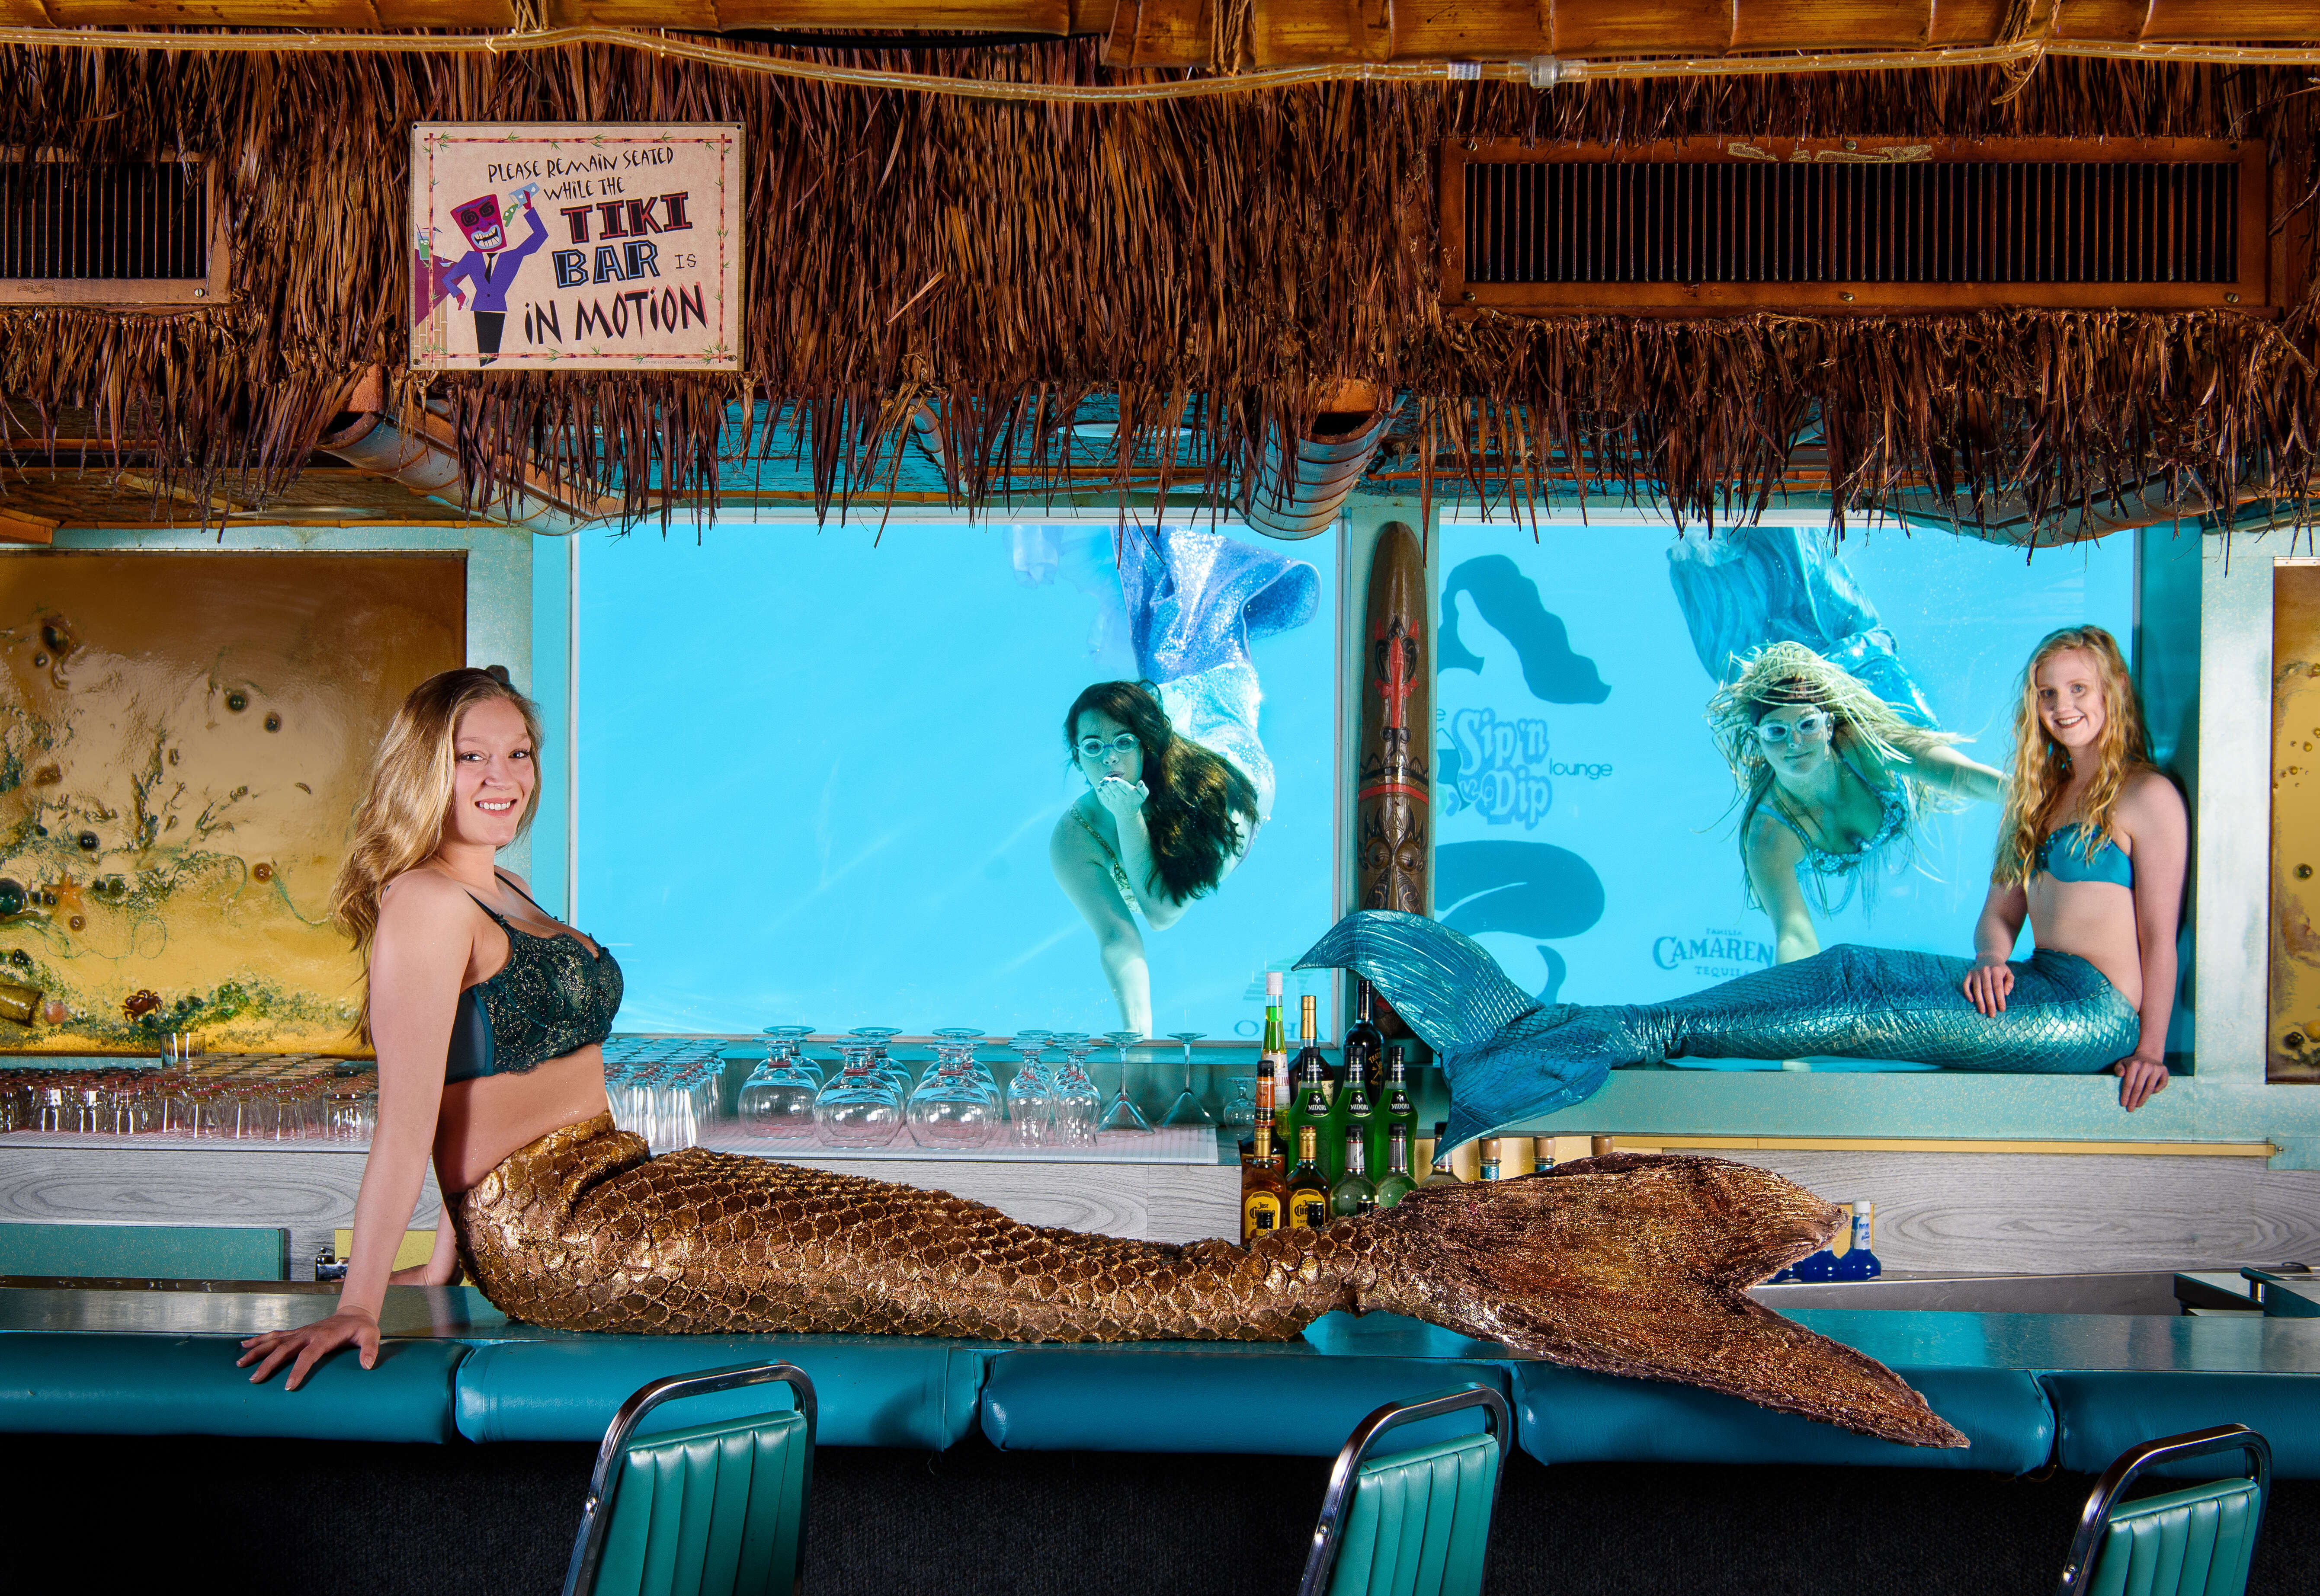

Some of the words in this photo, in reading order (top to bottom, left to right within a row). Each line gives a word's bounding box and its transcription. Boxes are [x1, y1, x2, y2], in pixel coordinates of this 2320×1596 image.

[488, 160, 541, 183] PLEASE
[622, 146, 673, 169] SEATED
[598, 176, 626, 196] THE
[560, 191, 693, 244] TIKI
[551, 240, 660, 289] BAR
[674, 253, 697, 269] IS
[1453, 708, 1549, 775] Sip'n
[1549, 758, 1613, 780] lounge
[1477, 765, 1552, 829] Dip
[1652, 936, 1774, 970] CAMAREN
